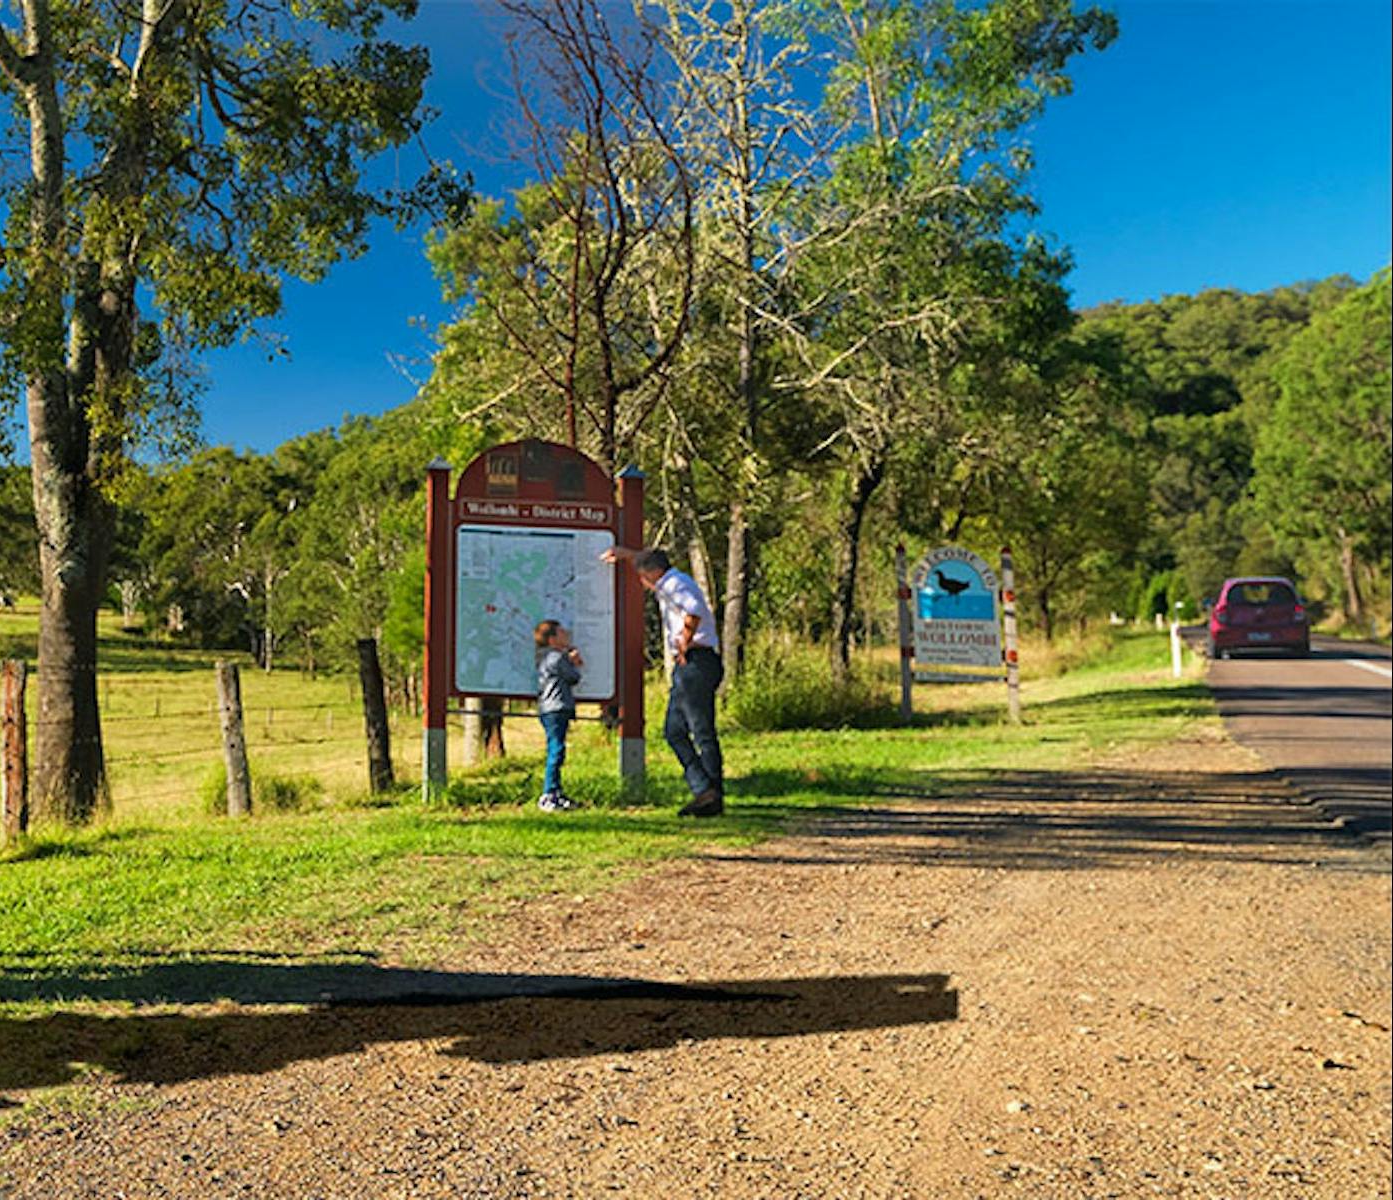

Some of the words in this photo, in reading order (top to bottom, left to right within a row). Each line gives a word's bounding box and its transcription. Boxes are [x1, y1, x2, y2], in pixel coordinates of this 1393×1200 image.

[466, 502, 519, 516] Wollombi
[532, 505, 576, 519] District
[579, 507, 606, 522] Map
[917, 631, 997, 646] WOLLOMBI
